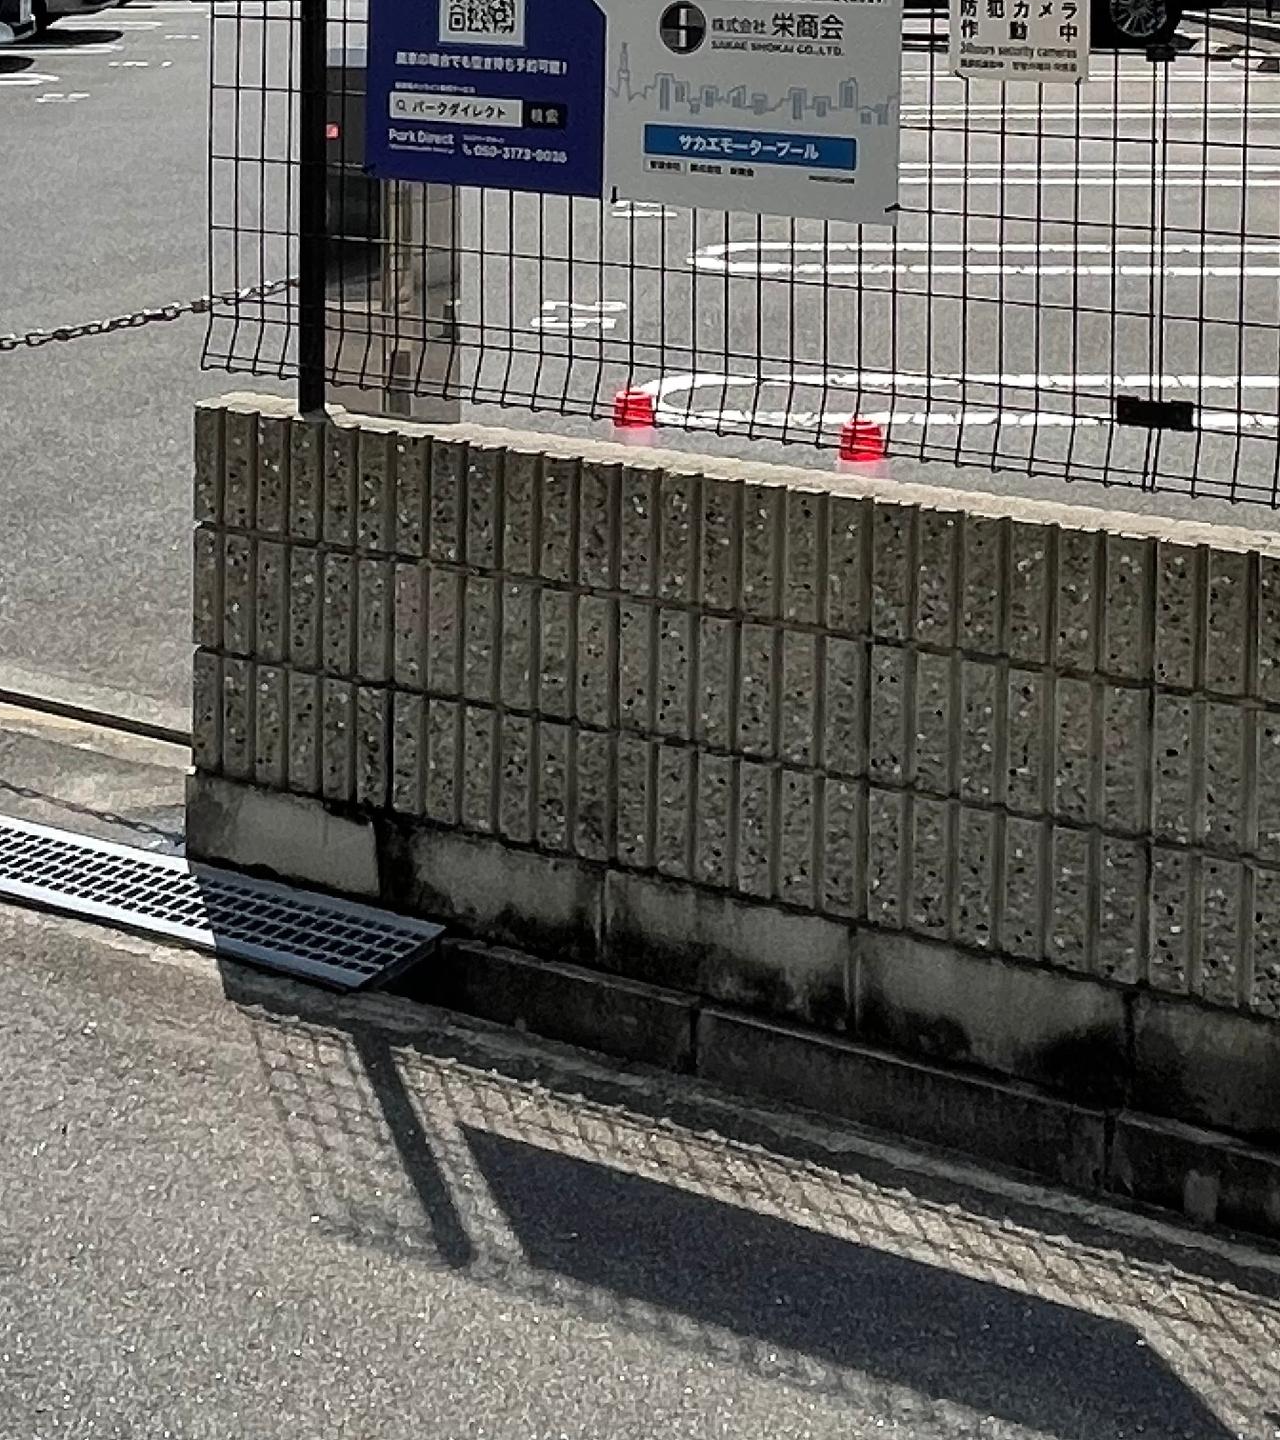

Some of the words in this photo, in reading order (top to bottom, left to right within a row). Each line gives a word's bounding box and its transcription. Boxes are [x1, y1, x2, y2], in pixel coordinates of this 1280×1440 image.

[711, 16, 767, 35] 株式会社
[771, 12, 845, 40] 栄商会
[960, 19, 1078, 43] 作動中
[998, 46, 1034, 59] security
[411, 100, 507, 119] パークダイレクト
[388, 128, 416, 142] Park
[678, 133, 819, 160] サカエモータープール
